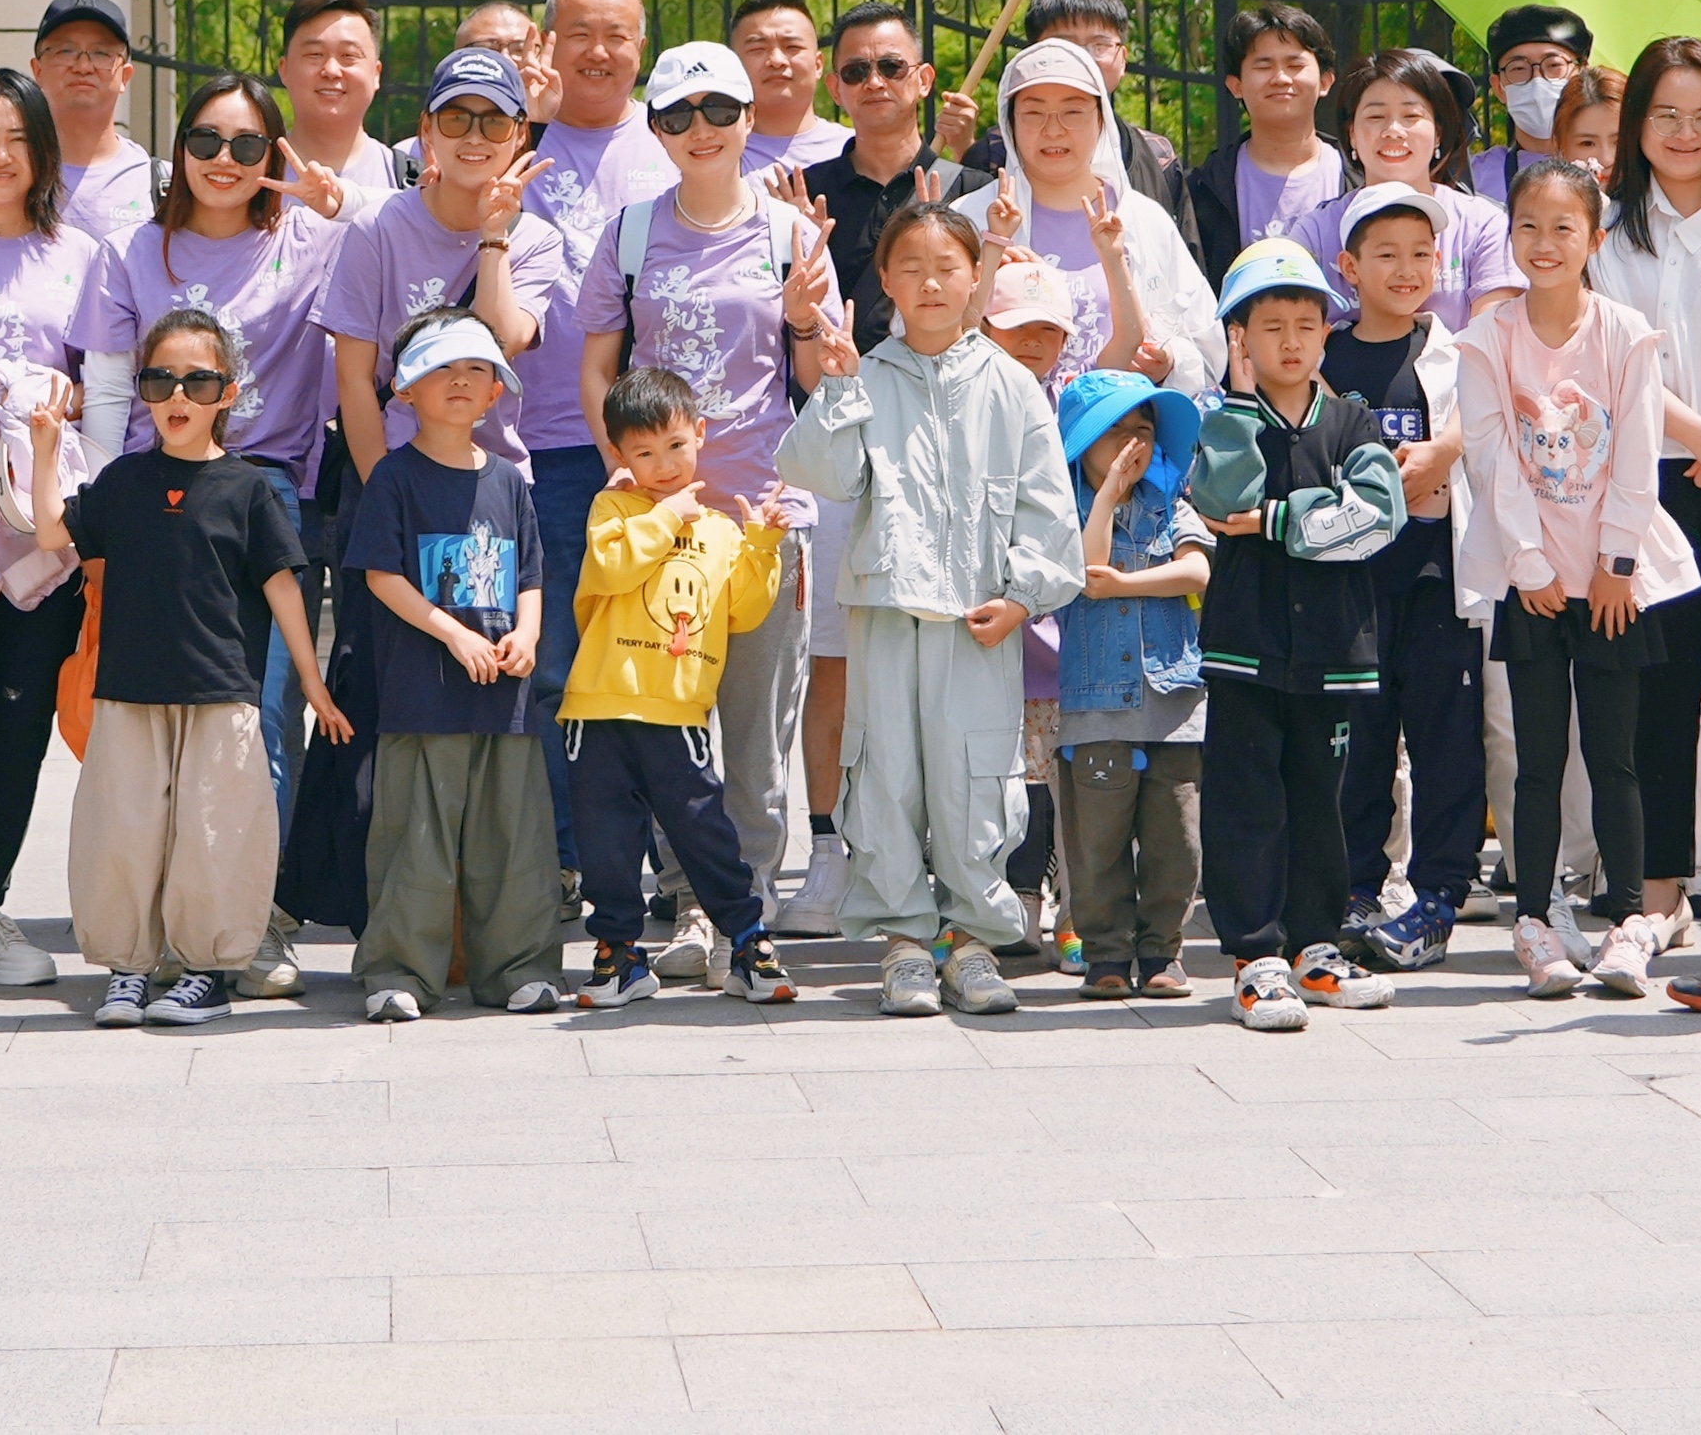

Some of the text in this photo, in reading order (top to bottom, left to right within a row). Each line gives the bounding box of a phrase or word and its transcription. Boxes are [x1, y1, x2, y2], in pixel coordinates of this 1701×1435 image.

[1382, 414, 1417, 436] CE
[1534, 487, 1586, 504] JEANSWEST
[674, 536, 707, 554] MILE
[617, 637, 643, 647] EVERY
[644, 641, 661, 651] DAY
[685, 648, 703, 659] OOD
